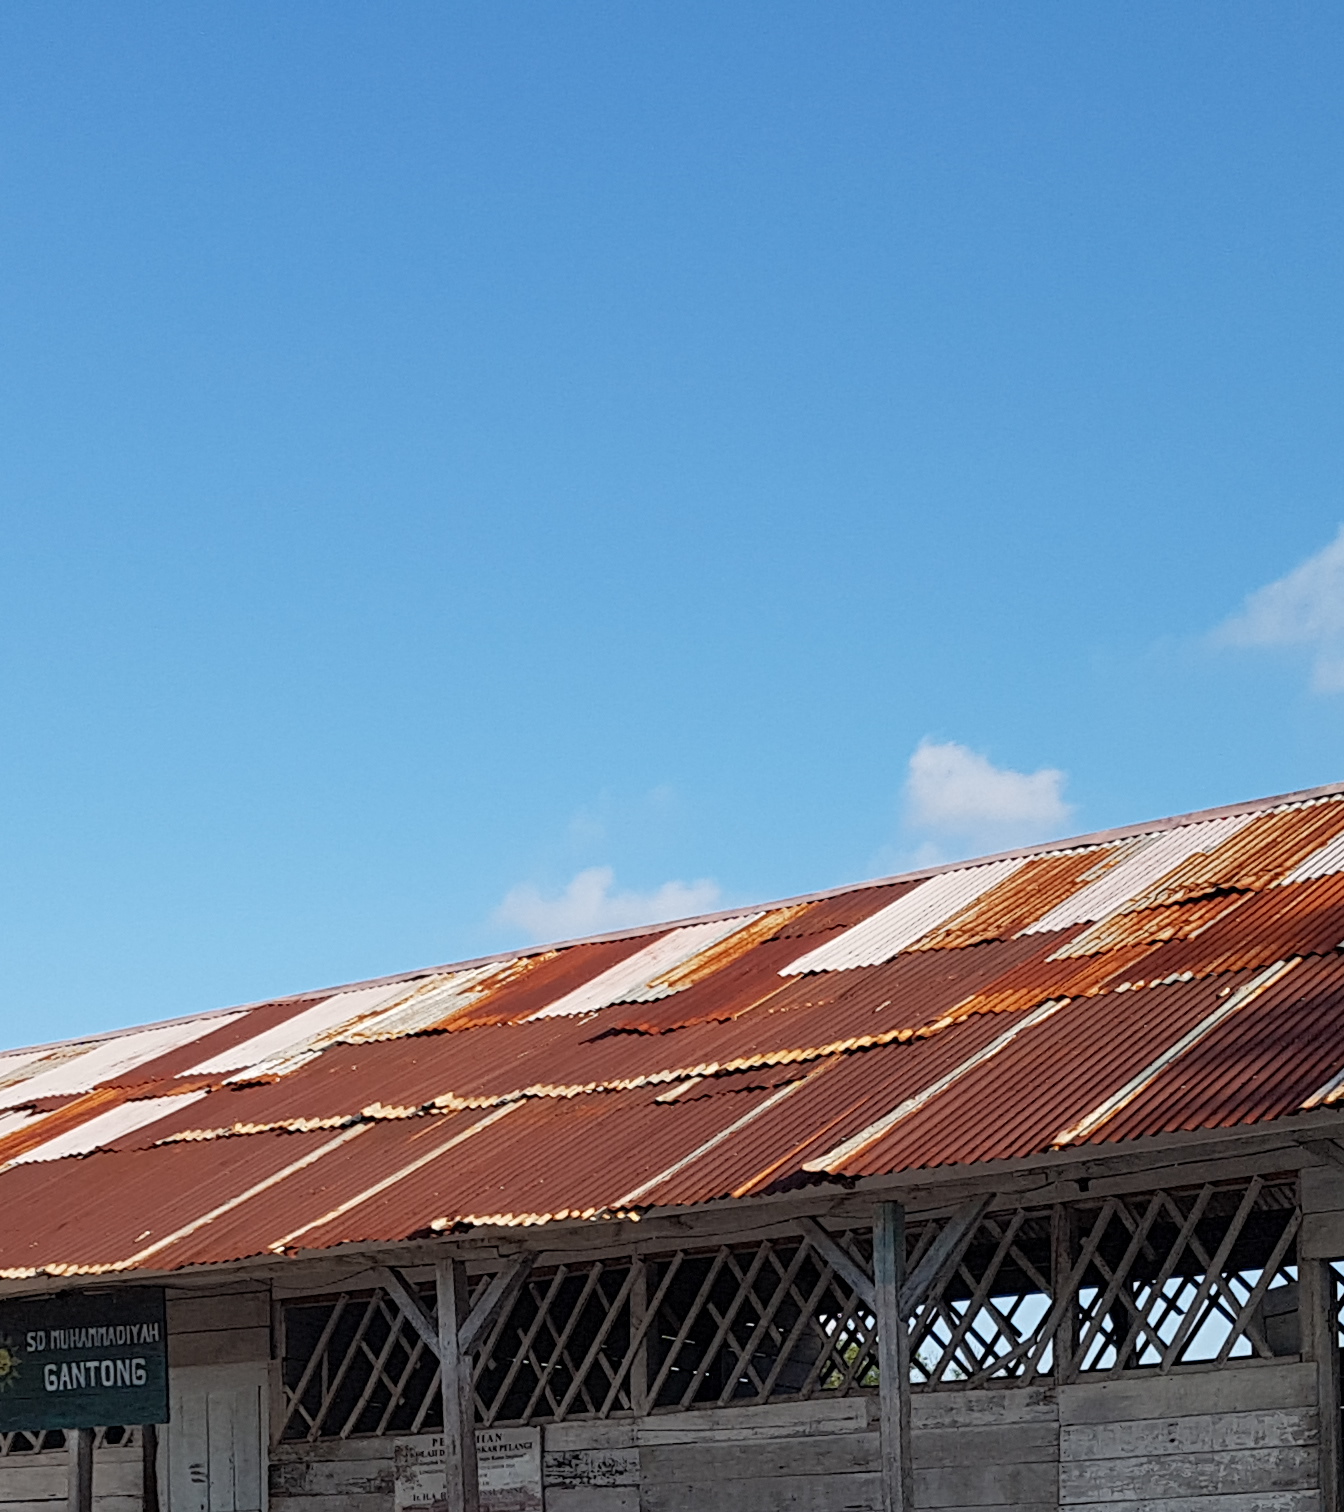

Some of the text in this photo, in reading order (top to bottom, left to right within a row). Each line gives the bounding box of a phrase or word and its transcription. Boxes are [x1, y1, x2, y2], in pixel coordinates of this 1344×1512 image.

[26, 1322, 159, 1352] SD MUHAMMADIYAH
[43, 1358, 147, 1392] GANTONG
